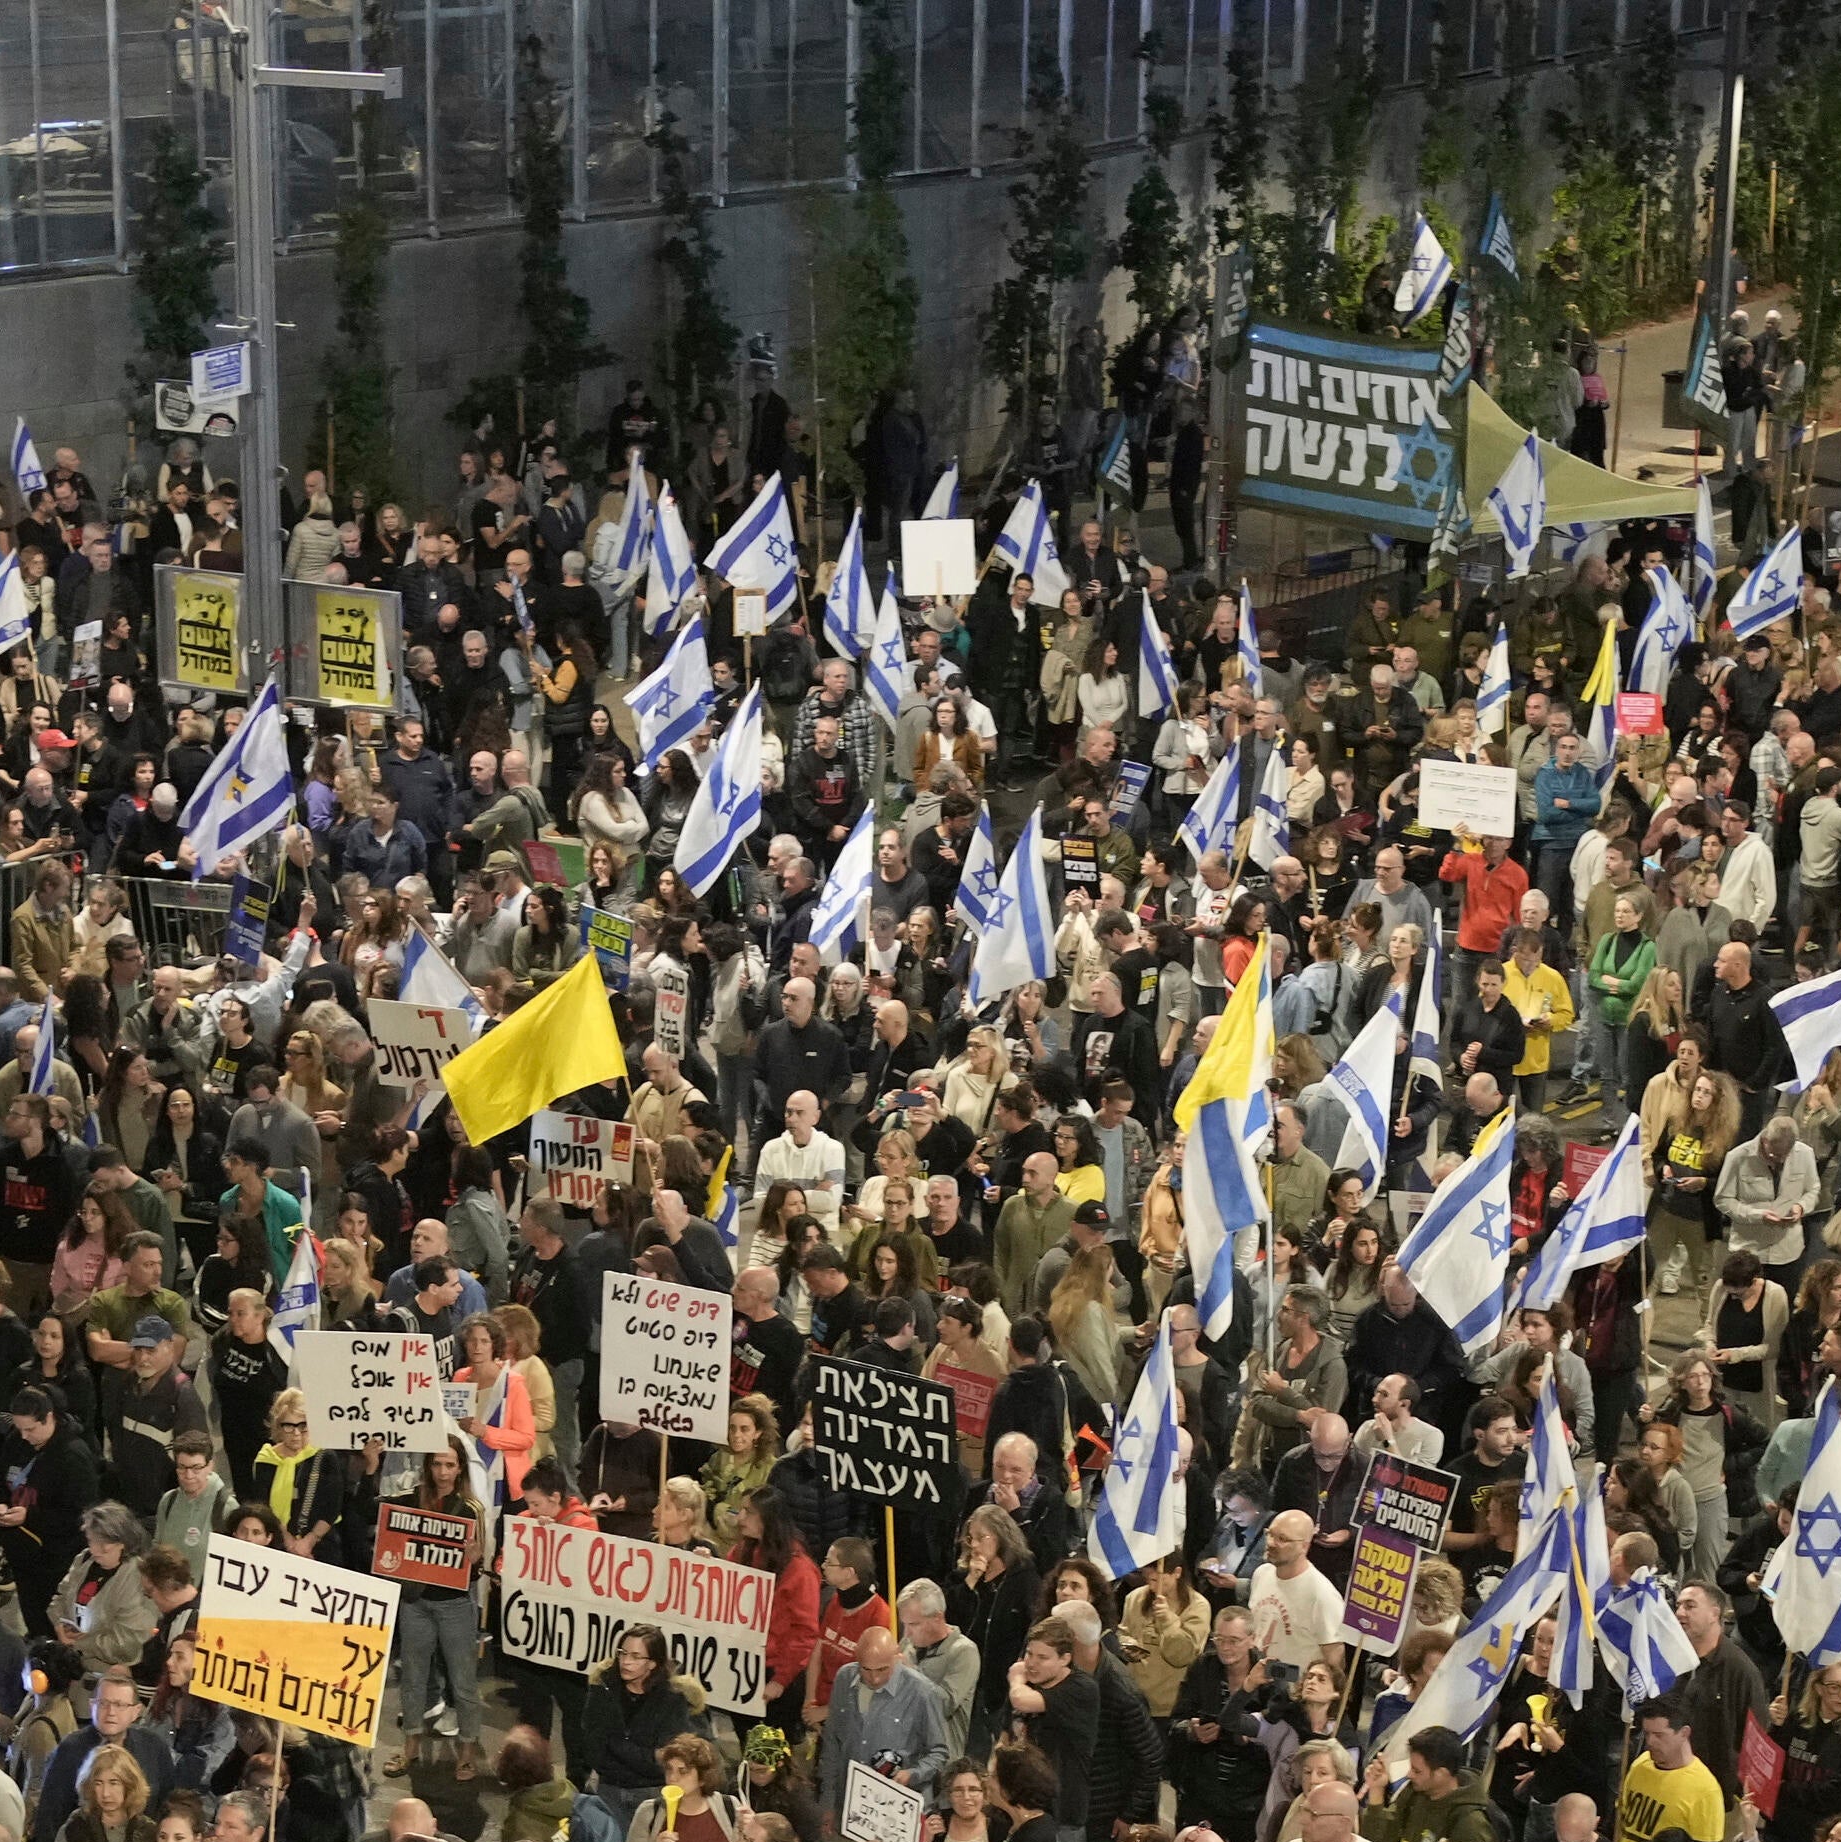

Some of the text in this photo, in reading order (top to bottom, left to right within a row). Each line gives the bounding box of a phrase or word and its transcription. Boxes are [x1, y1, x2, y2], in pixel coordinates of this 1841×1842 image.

[1244, 408, 1401, 490] לנשק
[180, 625, 231, 651] אשם
[321, 639, 374, 666] אשם
[180, 652, 233, 677] במחדל
[322, 667, 374, 692] במחדל
[417, 1009, 445, 1038] די
[564, 1116, 600, 1145] עד
[534, 1138, 602, 1173] החטוף
[612, 1280, 720, 1321] דיפ שיט ולא
[625, 1317, 718, 1350] דיפ סטייט
[351, 1340, 428, 1363] אין מים
[350, 1365, 431, 1395] אין אוכל
[654, 1354, 721, 1384] שאנחנו
[617, 1377, 715, 1411] נמצאים בו
[327, 1397, 433, 1425] תגיד להם
[821, 1407, 944, 1463] המדינה
[389, 1511, 466, 1541] פעימה אחת
[404, 1541, 464, 1569] לכולן.ם
[1360, 1541, 1412, 1576] עסקה
[208, 1553, 389, 1632] התקציב עבר
[1356, 1565, 1405, 1599] מלאה
[342, 1636, 385, 1681] על
